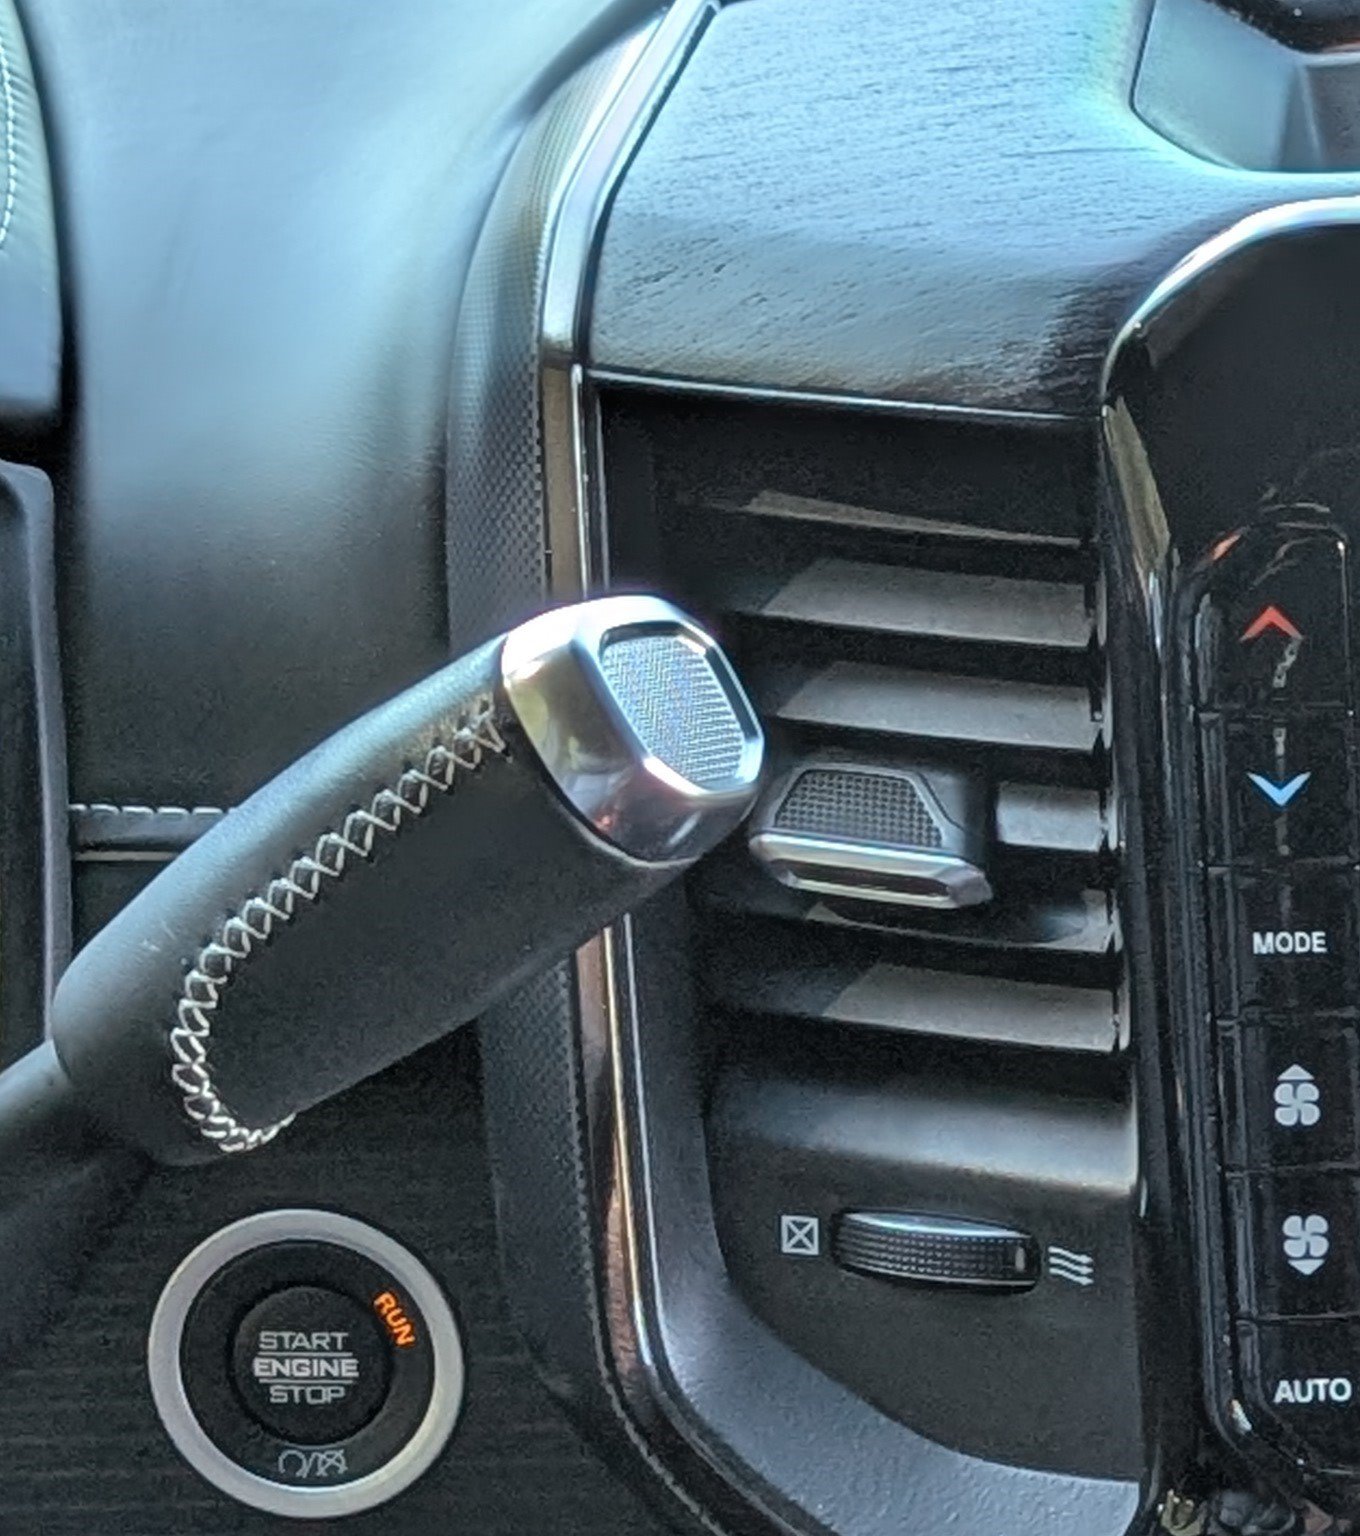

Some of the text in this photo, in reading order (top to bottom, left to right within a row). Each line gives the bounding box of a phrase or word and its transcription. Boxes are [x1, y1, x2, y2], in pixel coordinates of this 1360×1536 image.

[1252, 932, 1327, 954] MODE
[373, 1291, 416, 1347] RUN
[259, 1331, 348, 1350] START
[253, 1357, 359, 1378] ENGINE
[269, 1386, 346, 1405] STOP
[1273, 1378, 1352, 1403] AUTO
